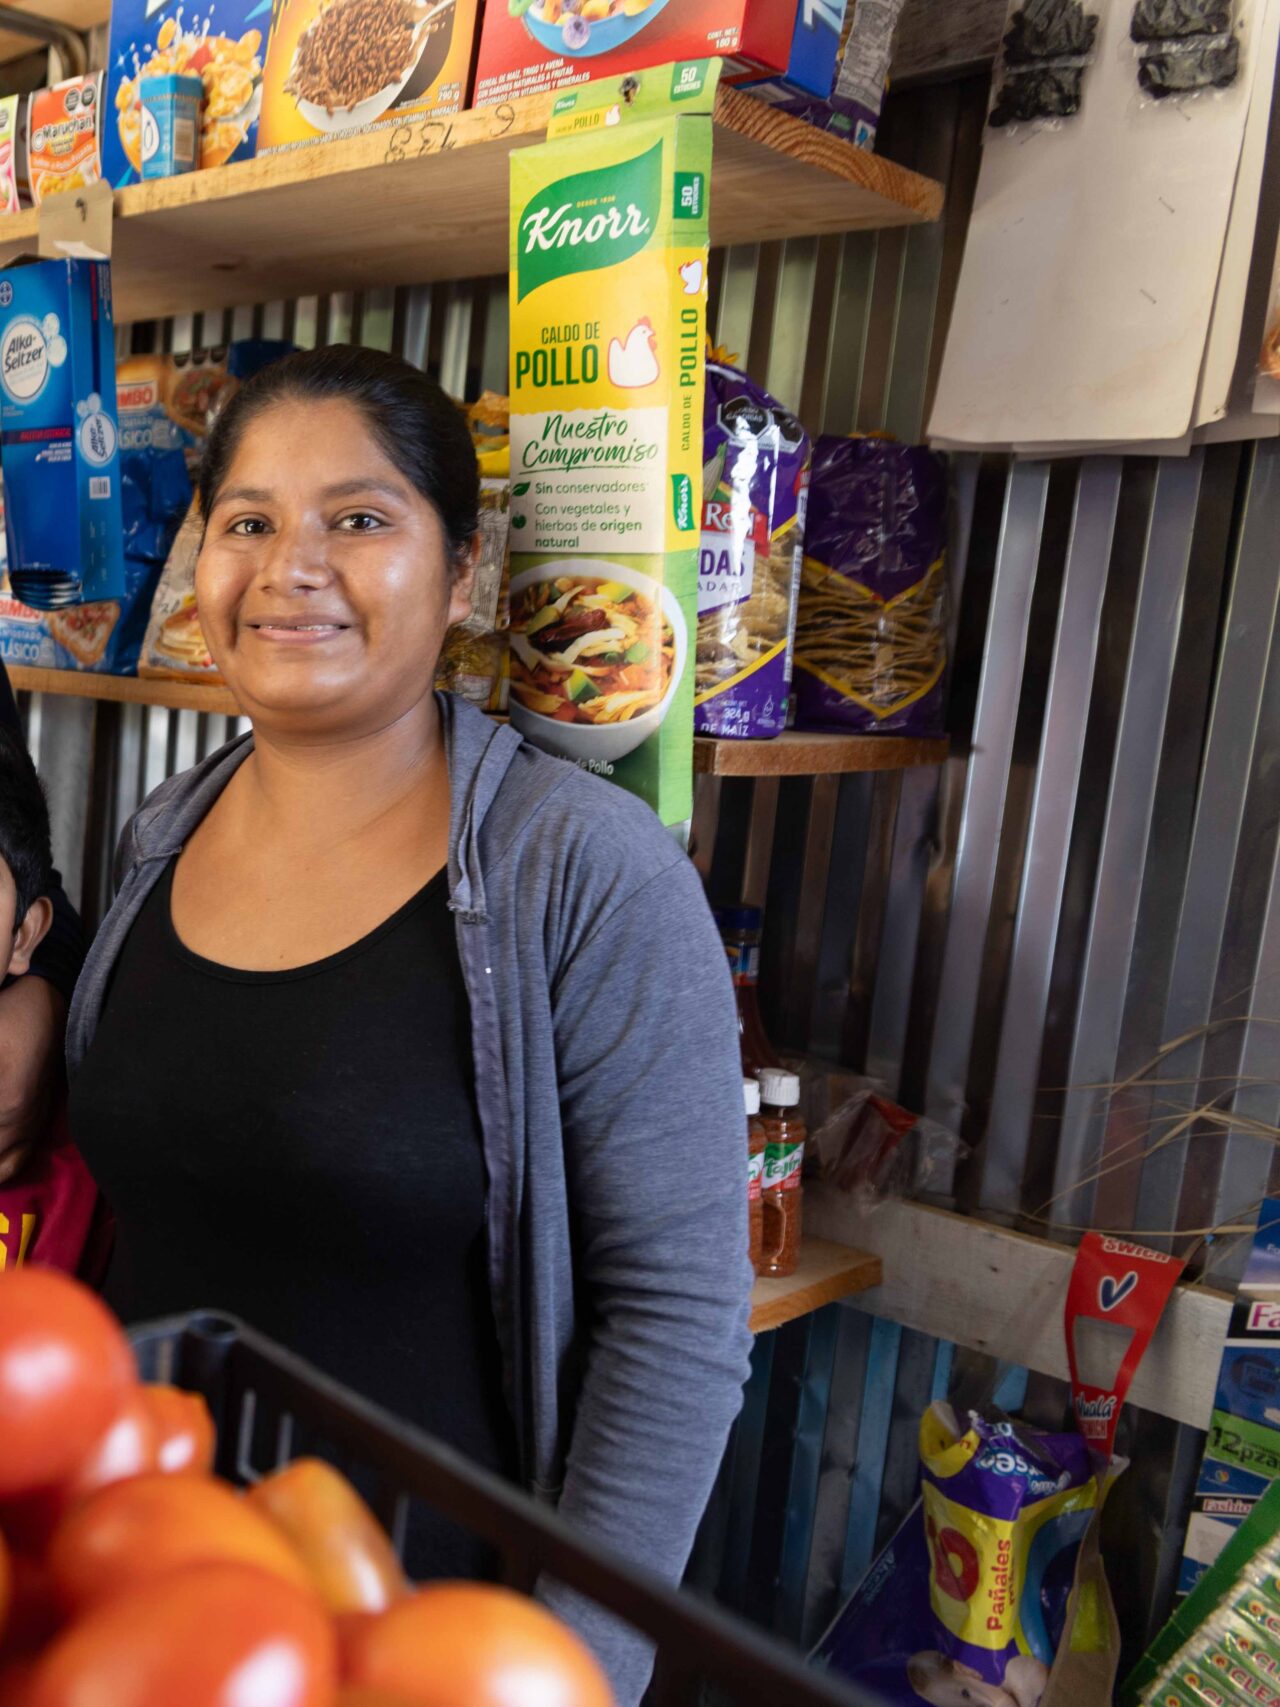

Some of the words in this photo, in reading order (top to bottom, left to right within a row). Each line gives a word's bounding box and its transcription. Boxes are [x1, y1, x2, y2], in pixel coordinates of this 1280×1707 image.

[680, 66, 697, 82] 50
[574, 114, 600, 129] POLLO
[681, 185, 693, 207] 50
[523, 203, 650, 254] Knorr
[6, 333, 37, 355] Alka-
[541, 324, 580, 345] CALDO
[585, 321, 601, 340] DE
[679, 308, 698, 388] POLLO
[5, 345, 44, 374] Seltzer
[516, 344, 599, 389] POLLO
[683, 394, 692, 410] DE
[542, 411, 629, 446] Nuestro
[682, 413, 691, 452] CALDO
[522, 438, 659, 473] Compromiso
[535, 481, 554, 494] Sin
[535, 502, 558, 515] Con
[560, 501, 621, 518] vegetales
[624, 504, 631, 518] y
[535, 517, 578, 532] hierbas
[581, 518, 597, 532] de
[600, 519, 642, 535] origen
[535, 536, 580, 548] natural
[588, 758, 615, 776] Pollo
[986, 1538, 1013, 1633] Pañales
